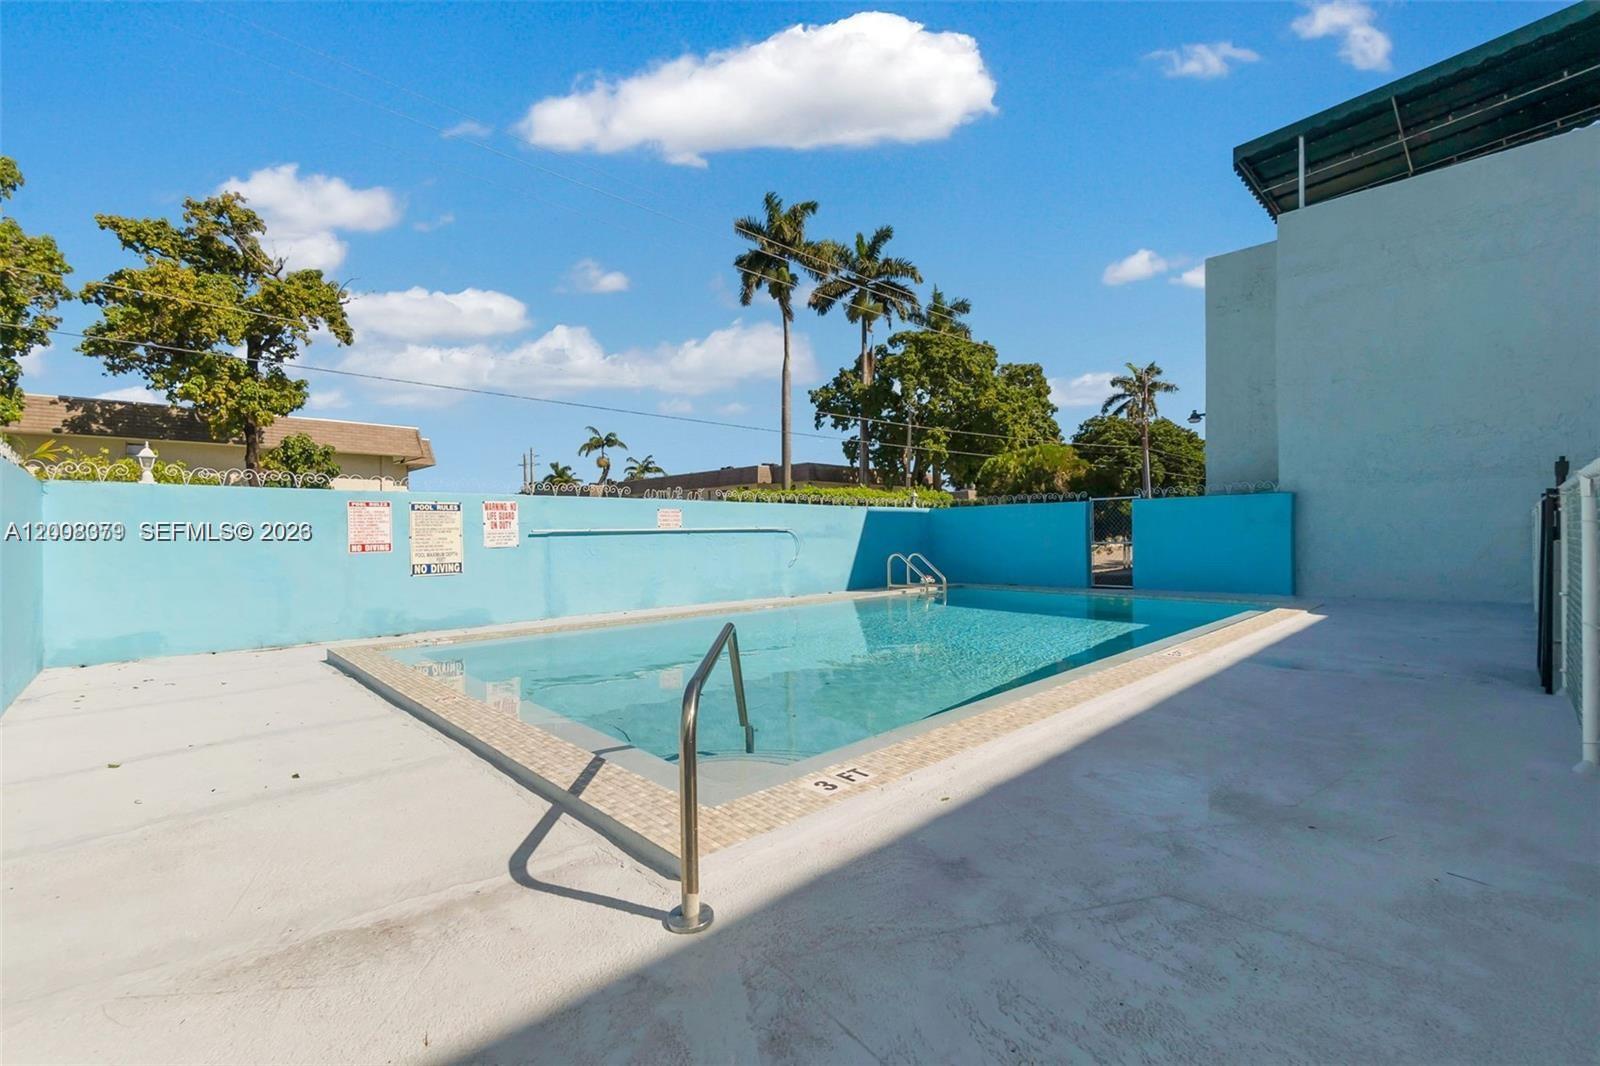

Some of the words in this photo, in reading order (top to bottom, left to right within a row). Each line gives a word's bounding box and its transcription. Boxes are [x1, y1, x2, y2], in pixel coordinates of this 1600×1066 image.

[510, 503, 516, 511] NO
[487, 512, 497, 520] LIFE
[499, 512, 514, 520] GUARD
[490, 521, 497, 529] ON
[499, 521, 511, 529] DUTY
[351, 544, 362, 552] NO
[414, 564, 428, 574] NO
[431, 563, 460, 573] DIVING
[813, 780, 838, 791] 3
[836, 768, 869, 782] FT
